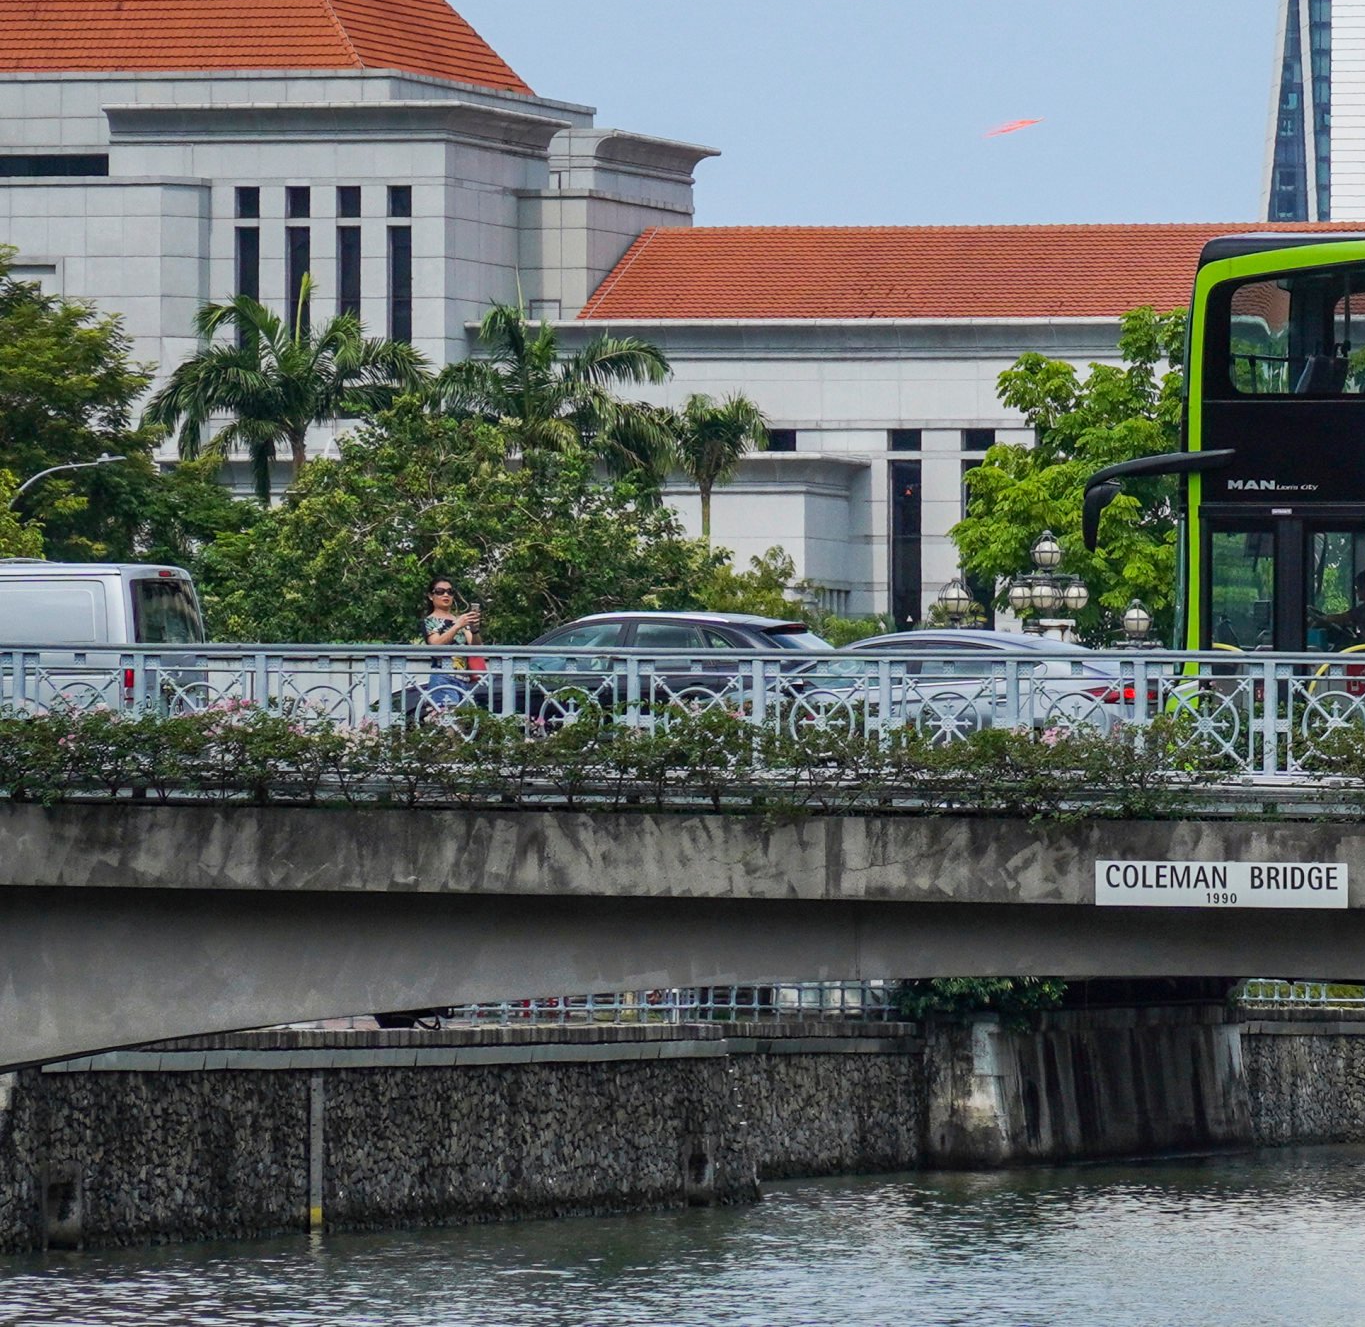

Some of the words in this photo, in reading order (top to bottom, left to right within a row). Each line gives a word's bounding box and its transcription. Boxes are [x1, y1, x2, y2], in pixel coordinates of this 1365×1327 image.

[1227, 479, 1275, 490] MAN
[1105, 864, 1227, 889] COLEMAN
[1250, 866, 1338, 890] BRIDGE
[1206, 892, 1237, 904] 1990
